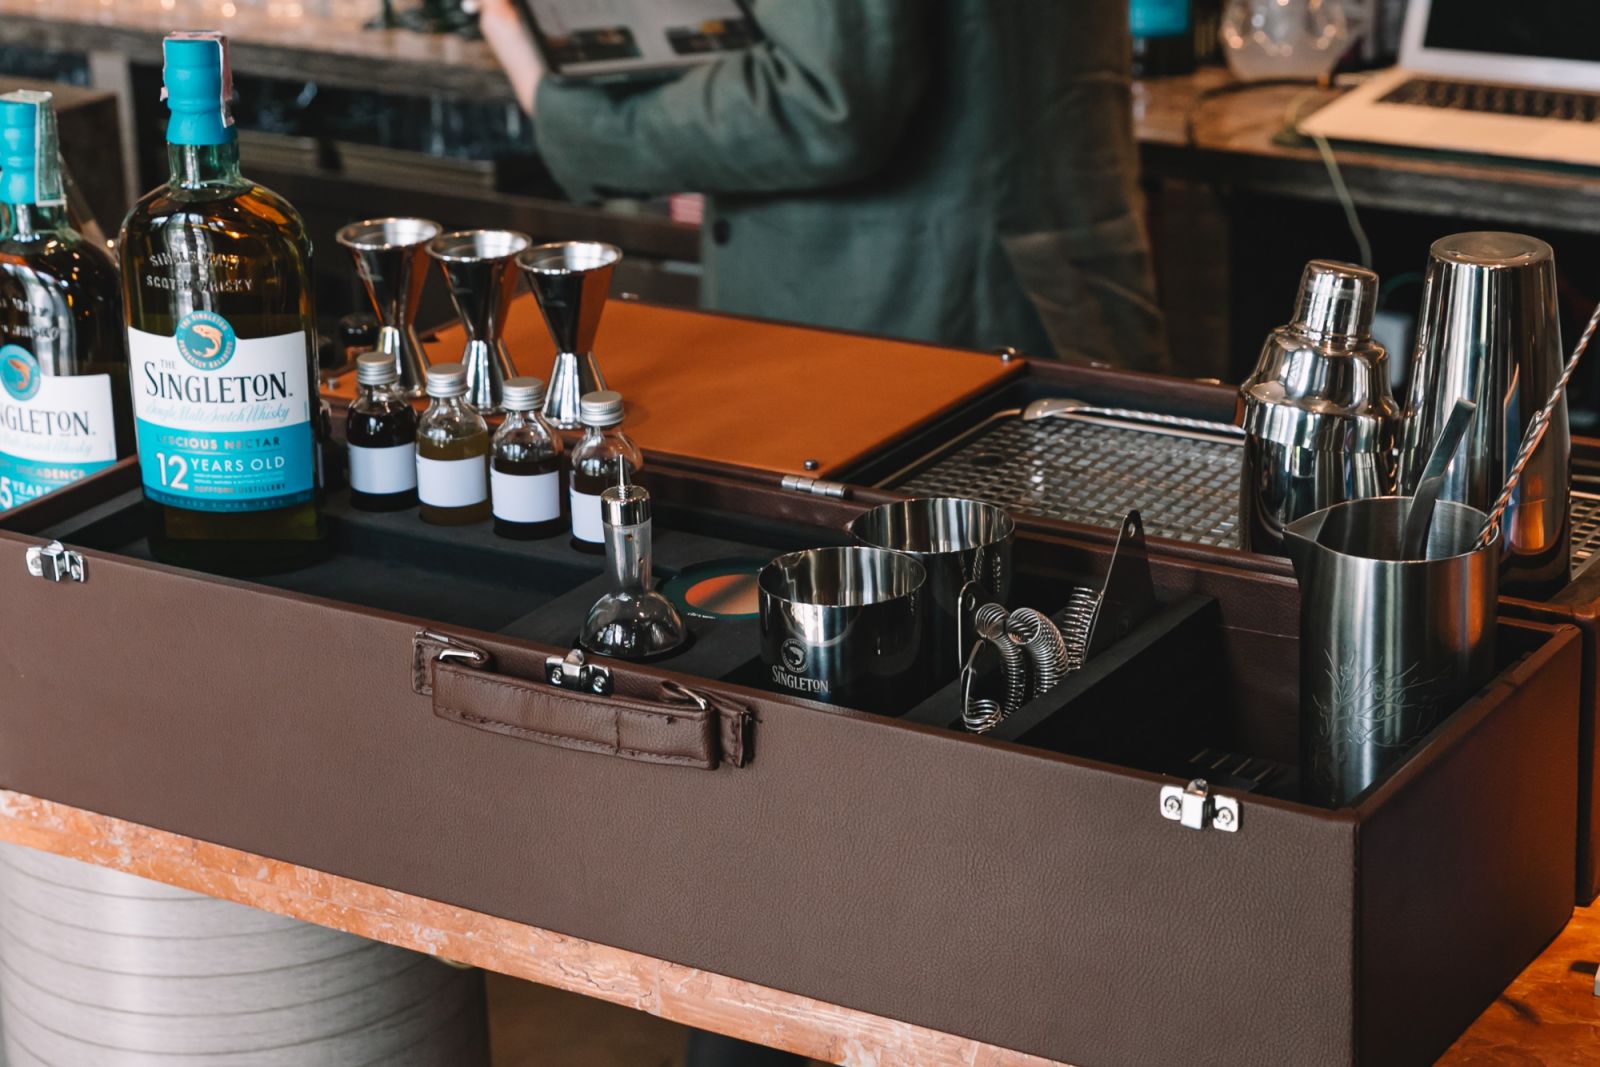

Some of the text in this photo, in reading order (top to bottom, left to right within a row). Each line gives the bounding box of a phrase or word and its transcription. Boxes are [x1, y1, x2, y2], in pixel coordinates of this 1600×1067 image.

[160, 359, 176, 370] THE
[156, 452, 189, 490] 12
[190, 456, 285, 472] YEARS OLD
[0, 476, 13, 509] 5
